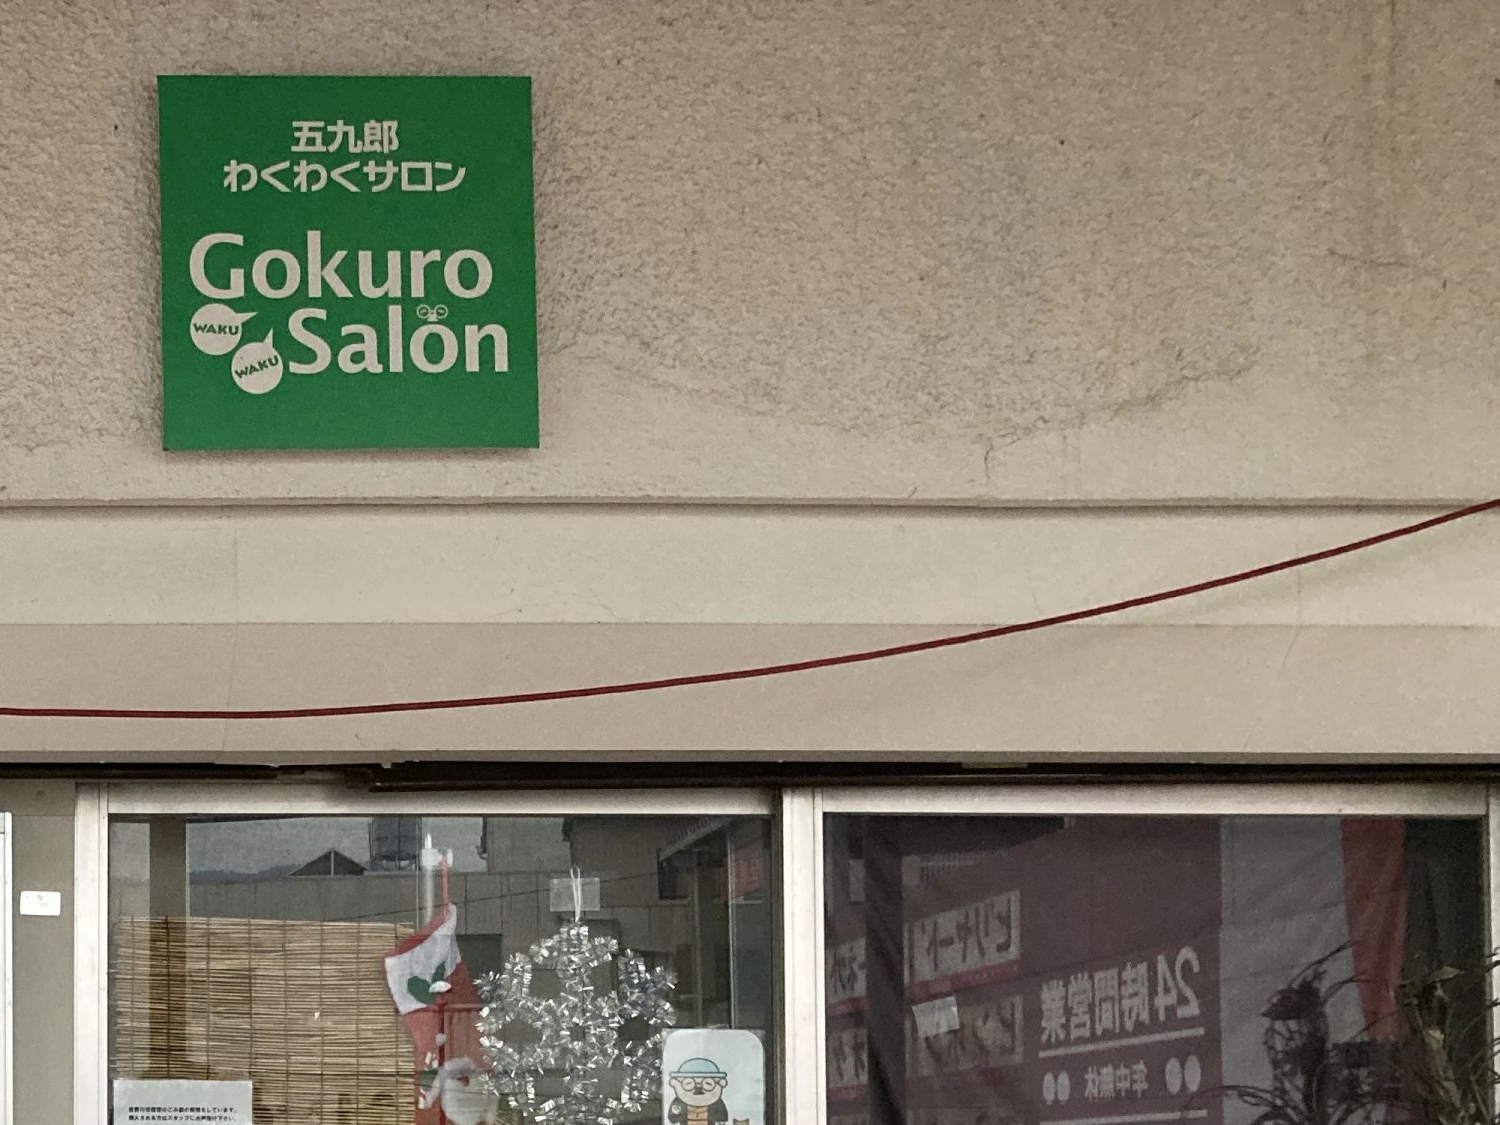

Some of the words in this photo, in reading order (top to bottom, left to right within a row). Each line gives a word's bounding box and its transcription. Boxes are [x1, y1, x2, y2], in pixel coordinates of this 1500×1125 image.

[291, 120, 399, 154] 五九郎
[223, 160, 466, 192] わくわくサロン
[189, 230, 493, 299] Gokuro
[193, 323, 239, 336] WAKU
[287, 304, 509, 374] Salon
[234, 355, 280, 379] WAKU
